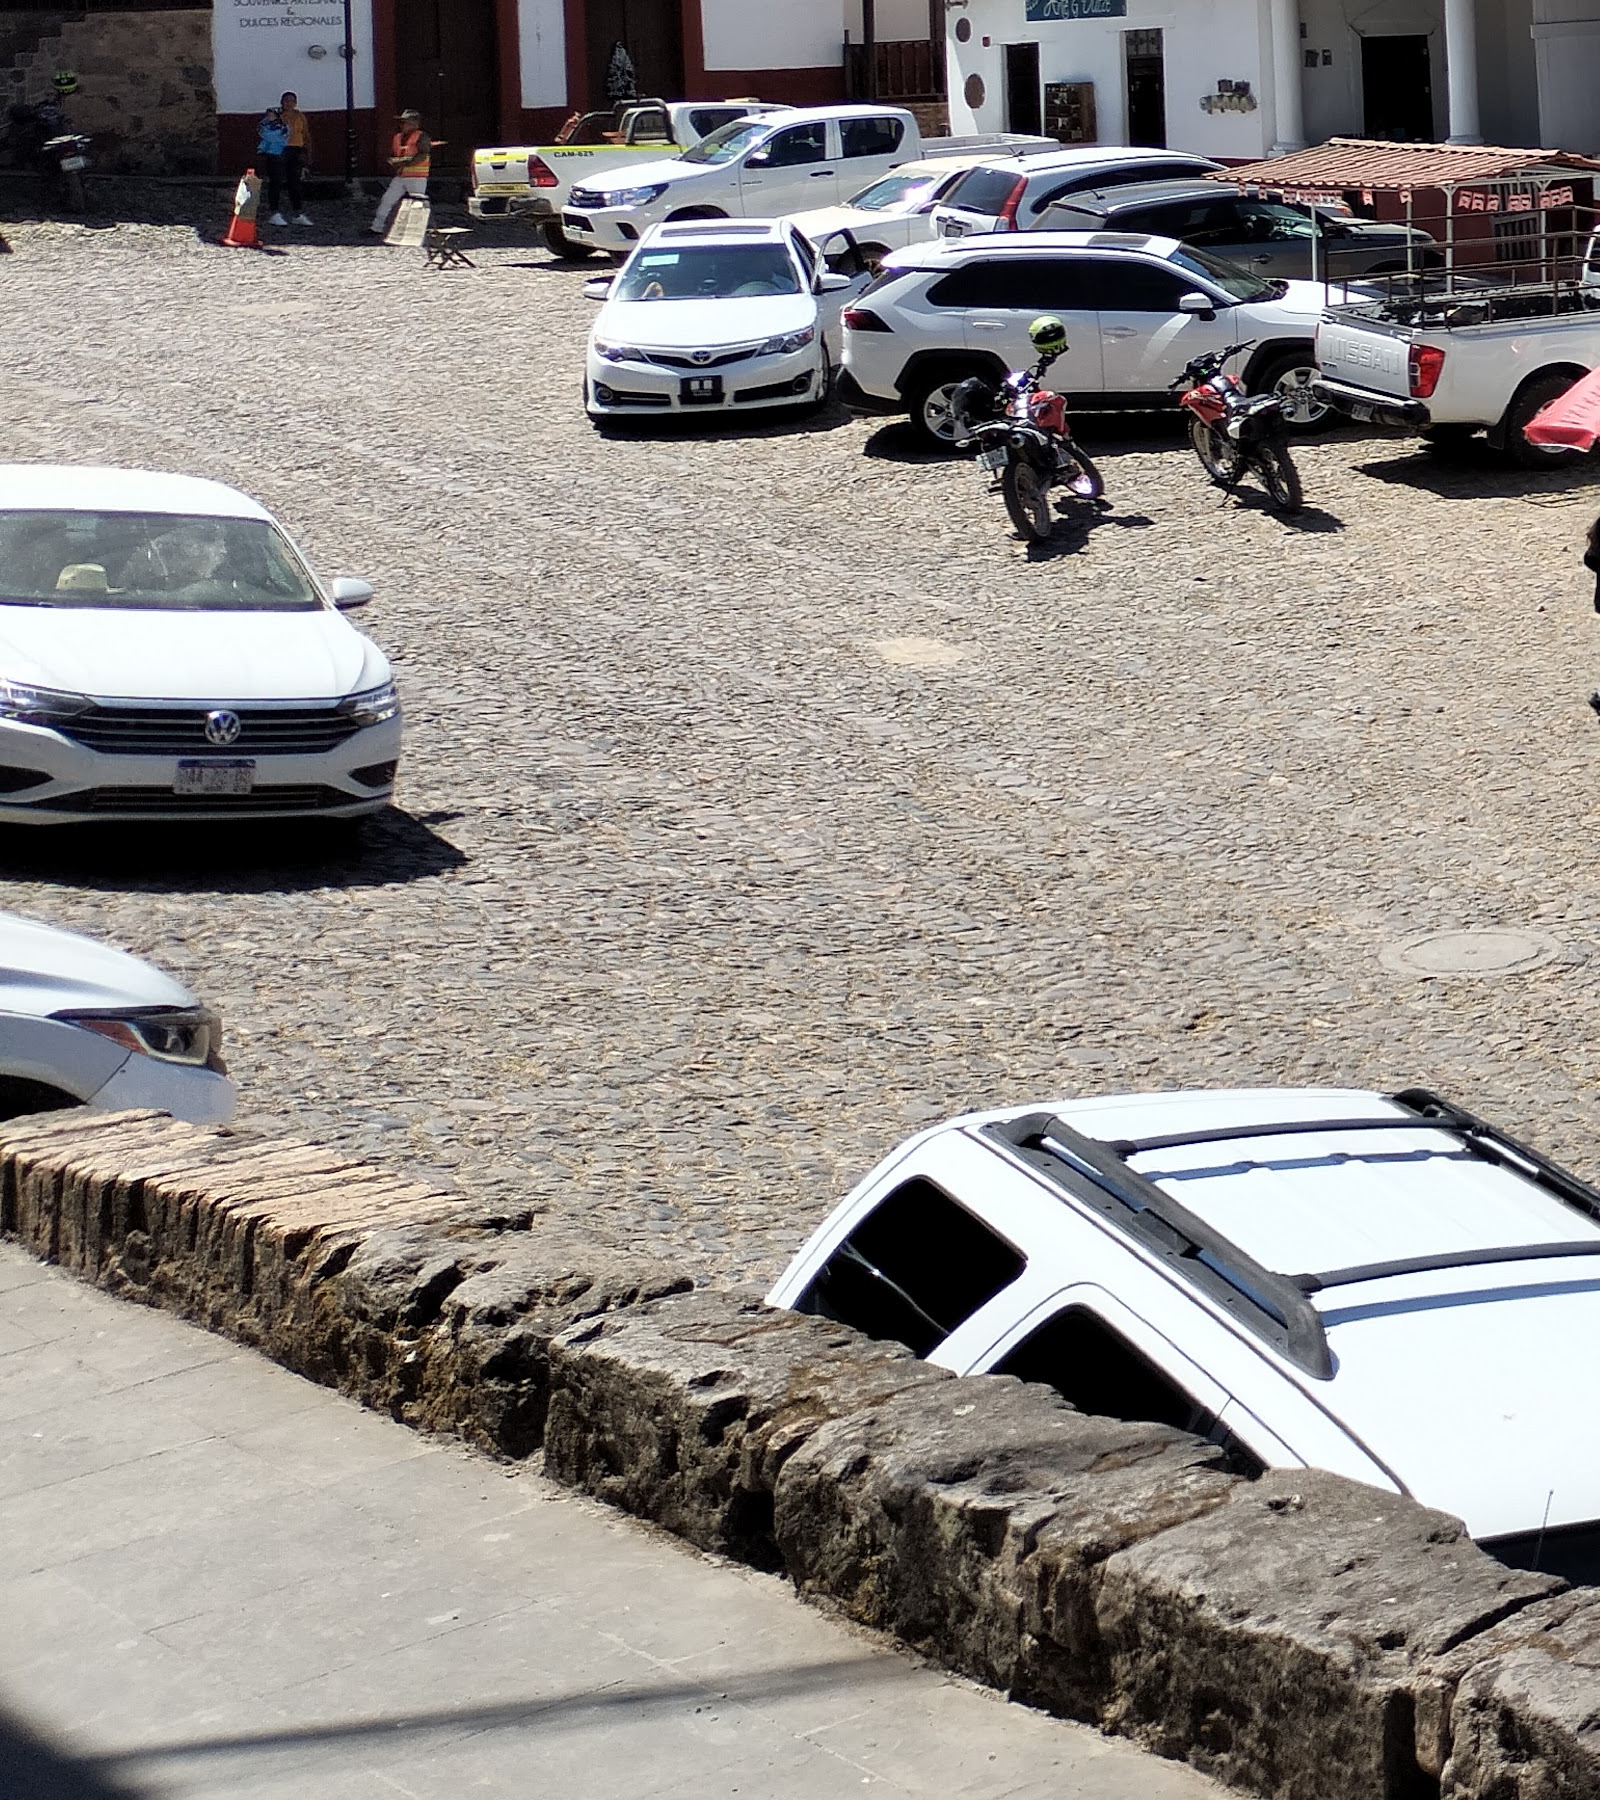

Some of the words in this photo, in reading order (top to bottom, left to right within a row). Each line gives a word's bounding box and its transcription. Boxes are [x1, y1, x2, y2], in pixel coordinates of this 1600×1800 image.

[240, 17, 279, 28] DULCES
[280, 15, 343, 27] REGIONALES
[1326, 334, 1401, 376] NISSAN
